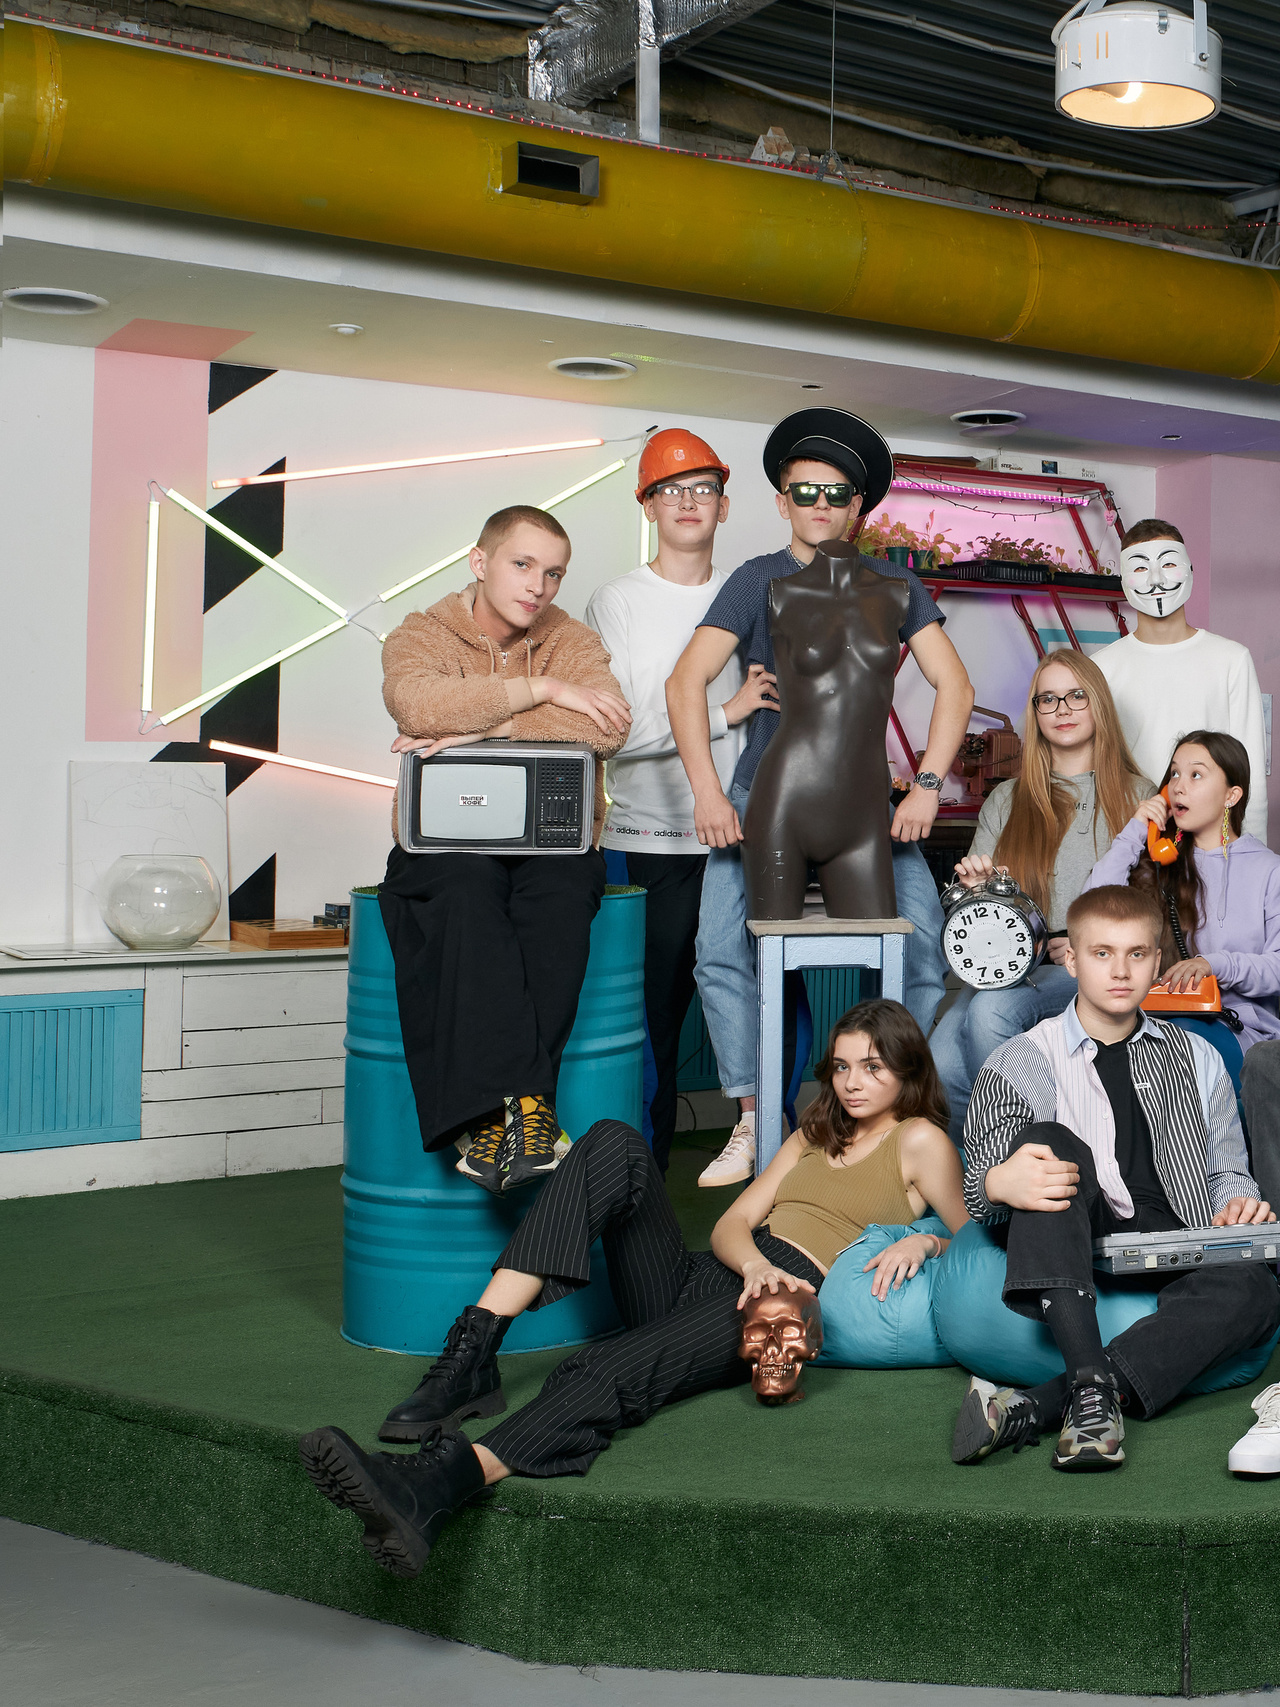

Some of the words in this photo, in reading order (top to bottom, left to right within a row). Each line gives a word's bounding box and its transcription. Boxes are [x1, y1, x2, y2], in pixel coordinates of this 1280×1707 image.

[615, 827, 640, 836] adidas
[653, 830, 683, 838] adidas
[972, 907, 989, 919] 12
[993, 909, 1000, 920] 1
[961, 914, 973, 926] 11
[1005, 918, 1017, 929] 2
[953, 928, 967, 940] 10
[1015, 932, 1027, 943] 3
[953, 944, 964, 955] 9
[1016, 946, 1027, 957] 4
[962, 958, 974, 969] 8
[1008, 960, 1019, 972] 5
[976, 966, 987, 978] 7
[993, 968, 1005, 979] 6
